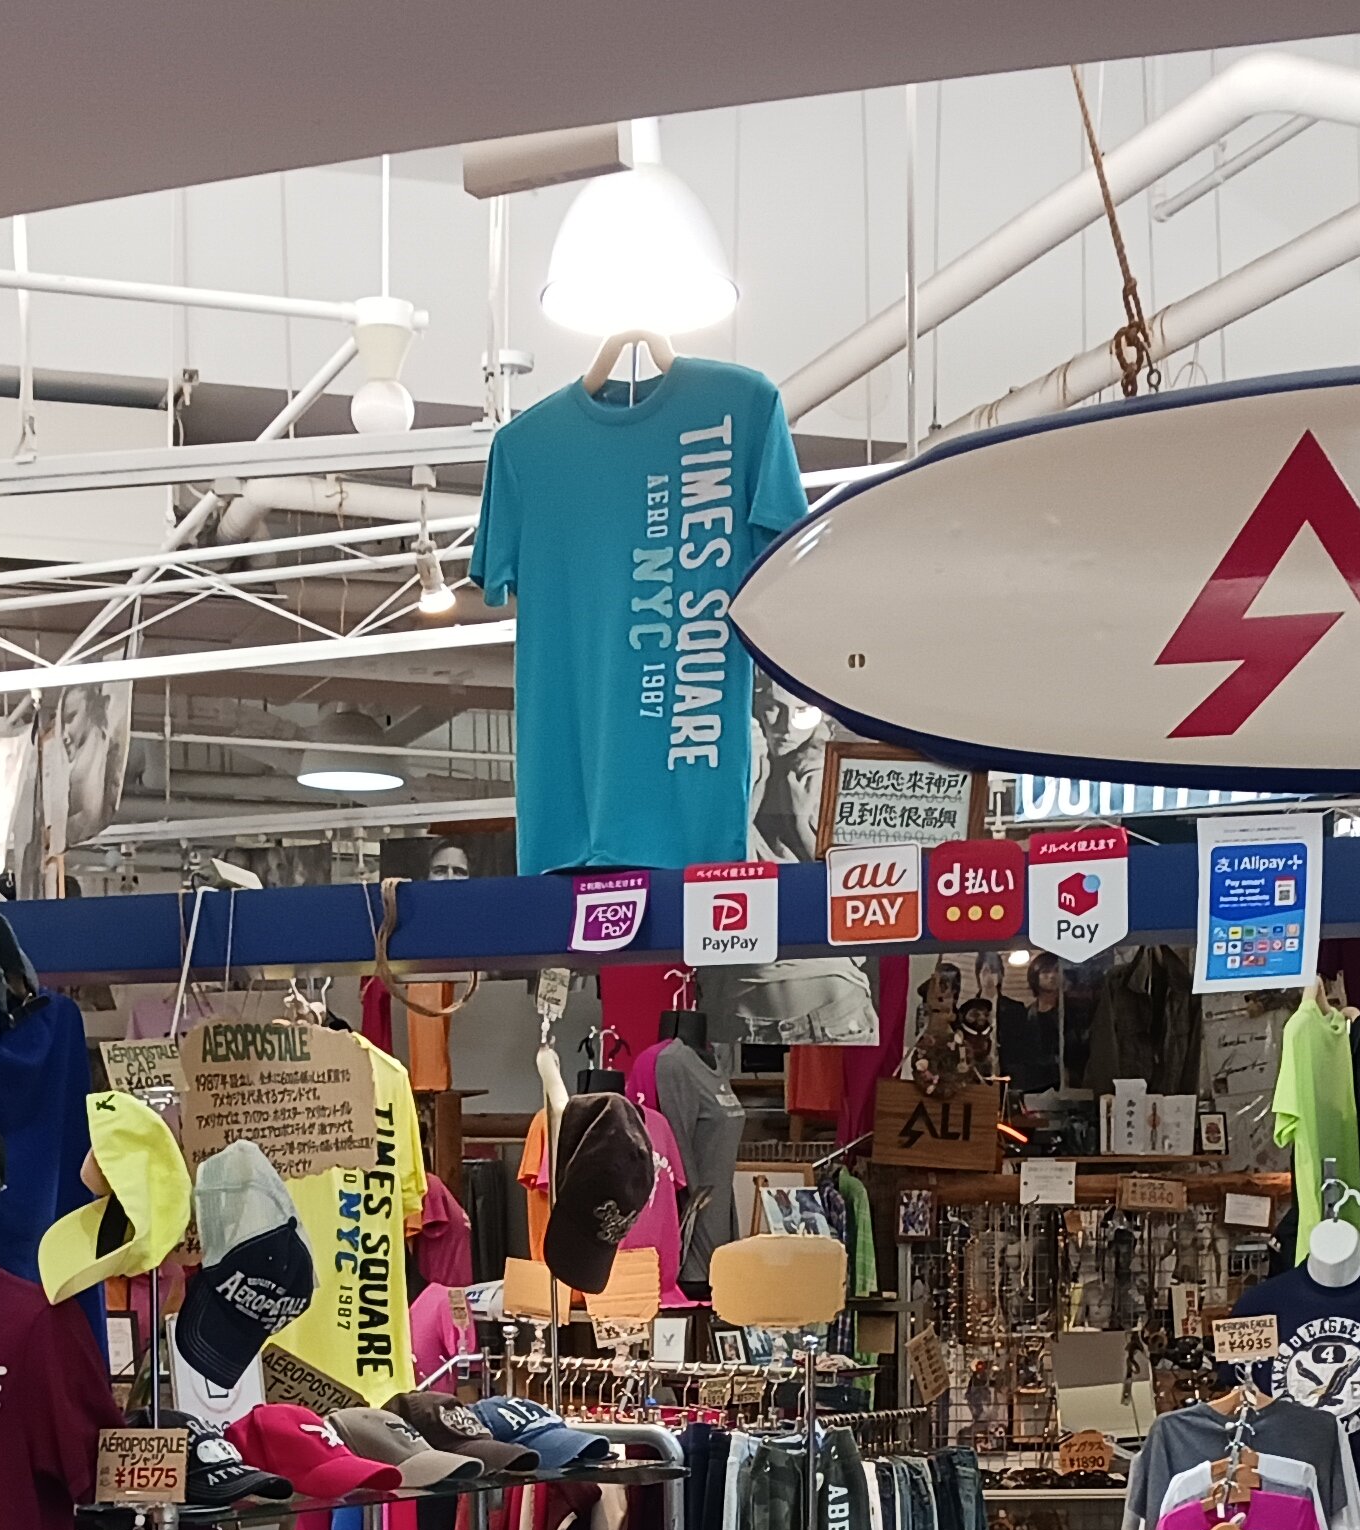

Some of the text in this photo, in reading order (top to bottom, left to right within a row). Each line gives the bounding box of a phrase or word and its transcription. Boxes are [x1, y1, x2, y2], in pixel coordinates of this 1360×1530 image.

[628, 474, 674, 719] AERO NYC 1987
[667, 414, 733, 770] TIMES SQUARE
[842, 862, 907, 889] au
[937, 863, 1015, 896] d払い
[846, 897, 903, 928] PAY
[702, 936, 759, 953] PayPay
[1057, 920, 1099, 943] Pay
[127, 1060, 156, 1076] CAP
[899, 1101, 973, 1148] ALI
[335, 1189, 362, 1275] NYC
[356, 1103, 396, 1377] TIMES SQUARE
[337, 1286, 353, 1330] 1987
[1304, 1319, 1360, 1339] EAGLE
[1320, 1346, 1335, 1362] 4
[100, 1432, 187, 1454] AÉROPOSTALE
[118, 1453, 165, 1467] Tシャツ
[114, 1467, 178, 1489] ¥1575
